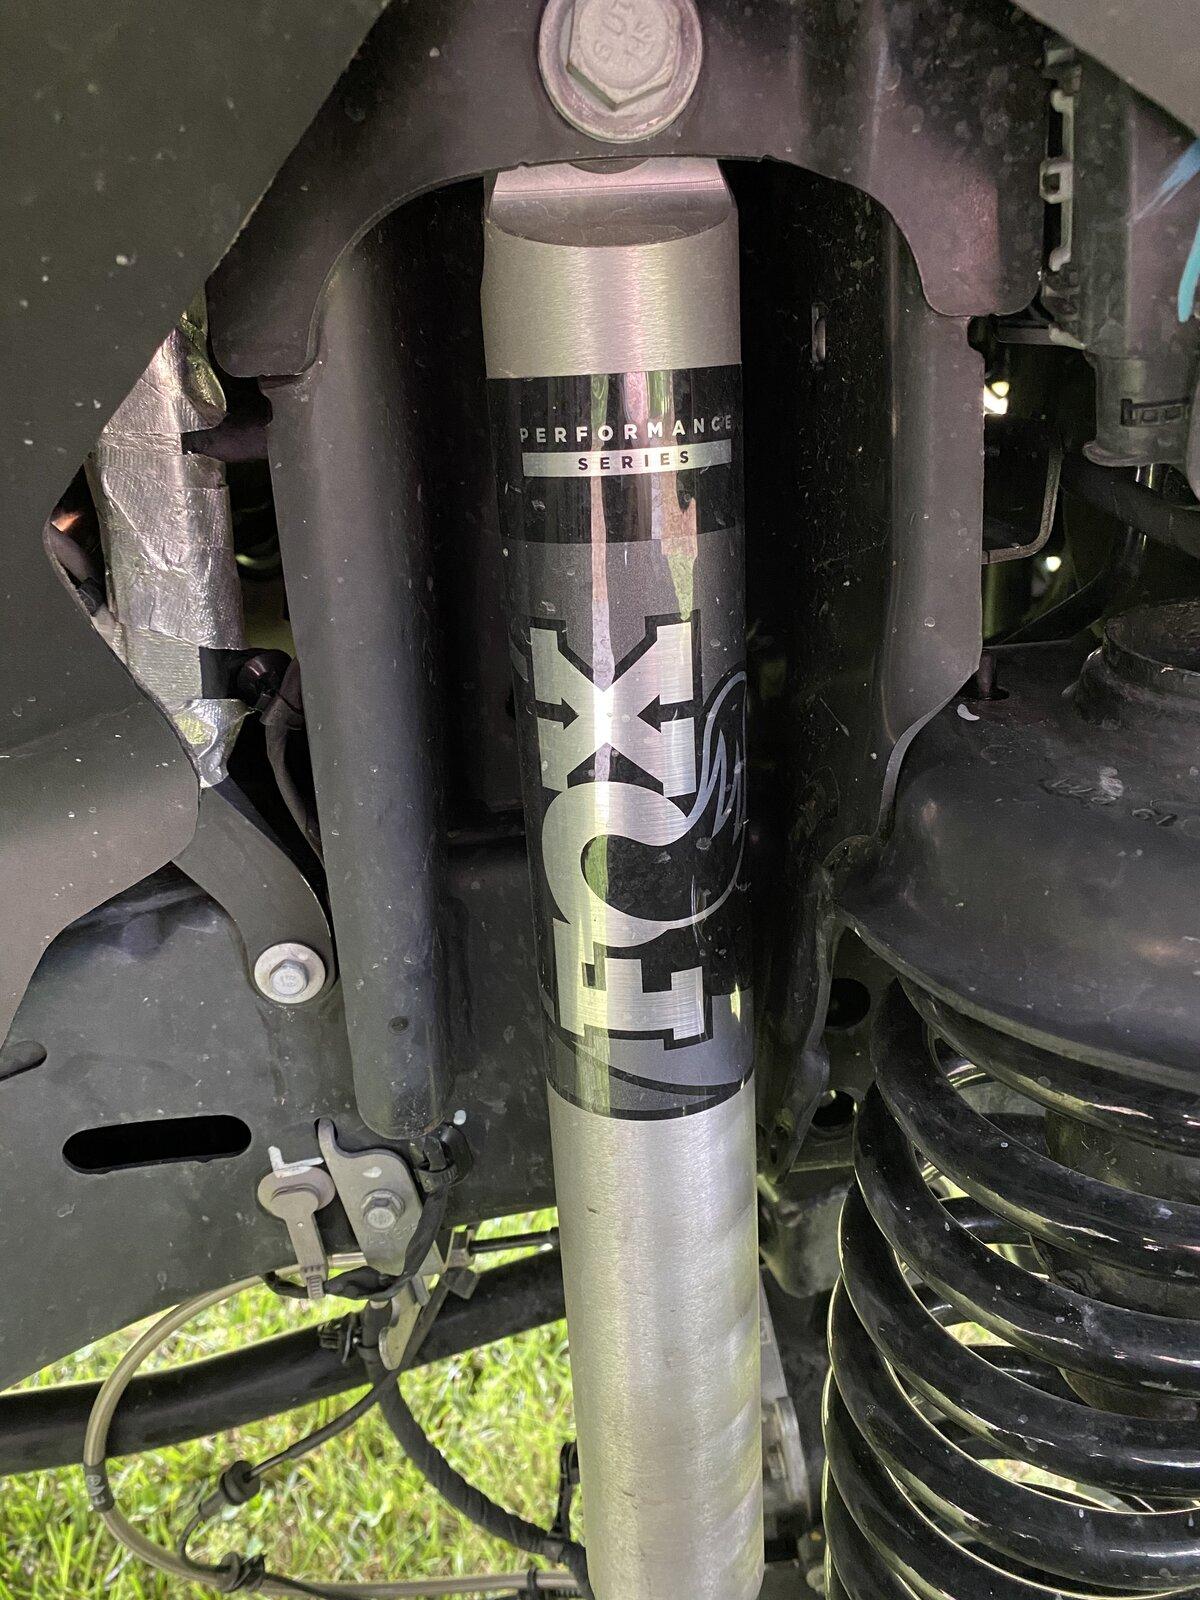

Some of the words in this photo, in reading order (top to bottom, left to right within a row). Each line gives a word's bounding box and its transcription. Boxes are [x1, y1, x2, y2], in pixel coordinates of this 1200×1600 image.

[520, 415, 731, 443] PERFORMANCE
[578, 451, 688, 470] SERIES
[529, 621, 746, 1041] FOX
